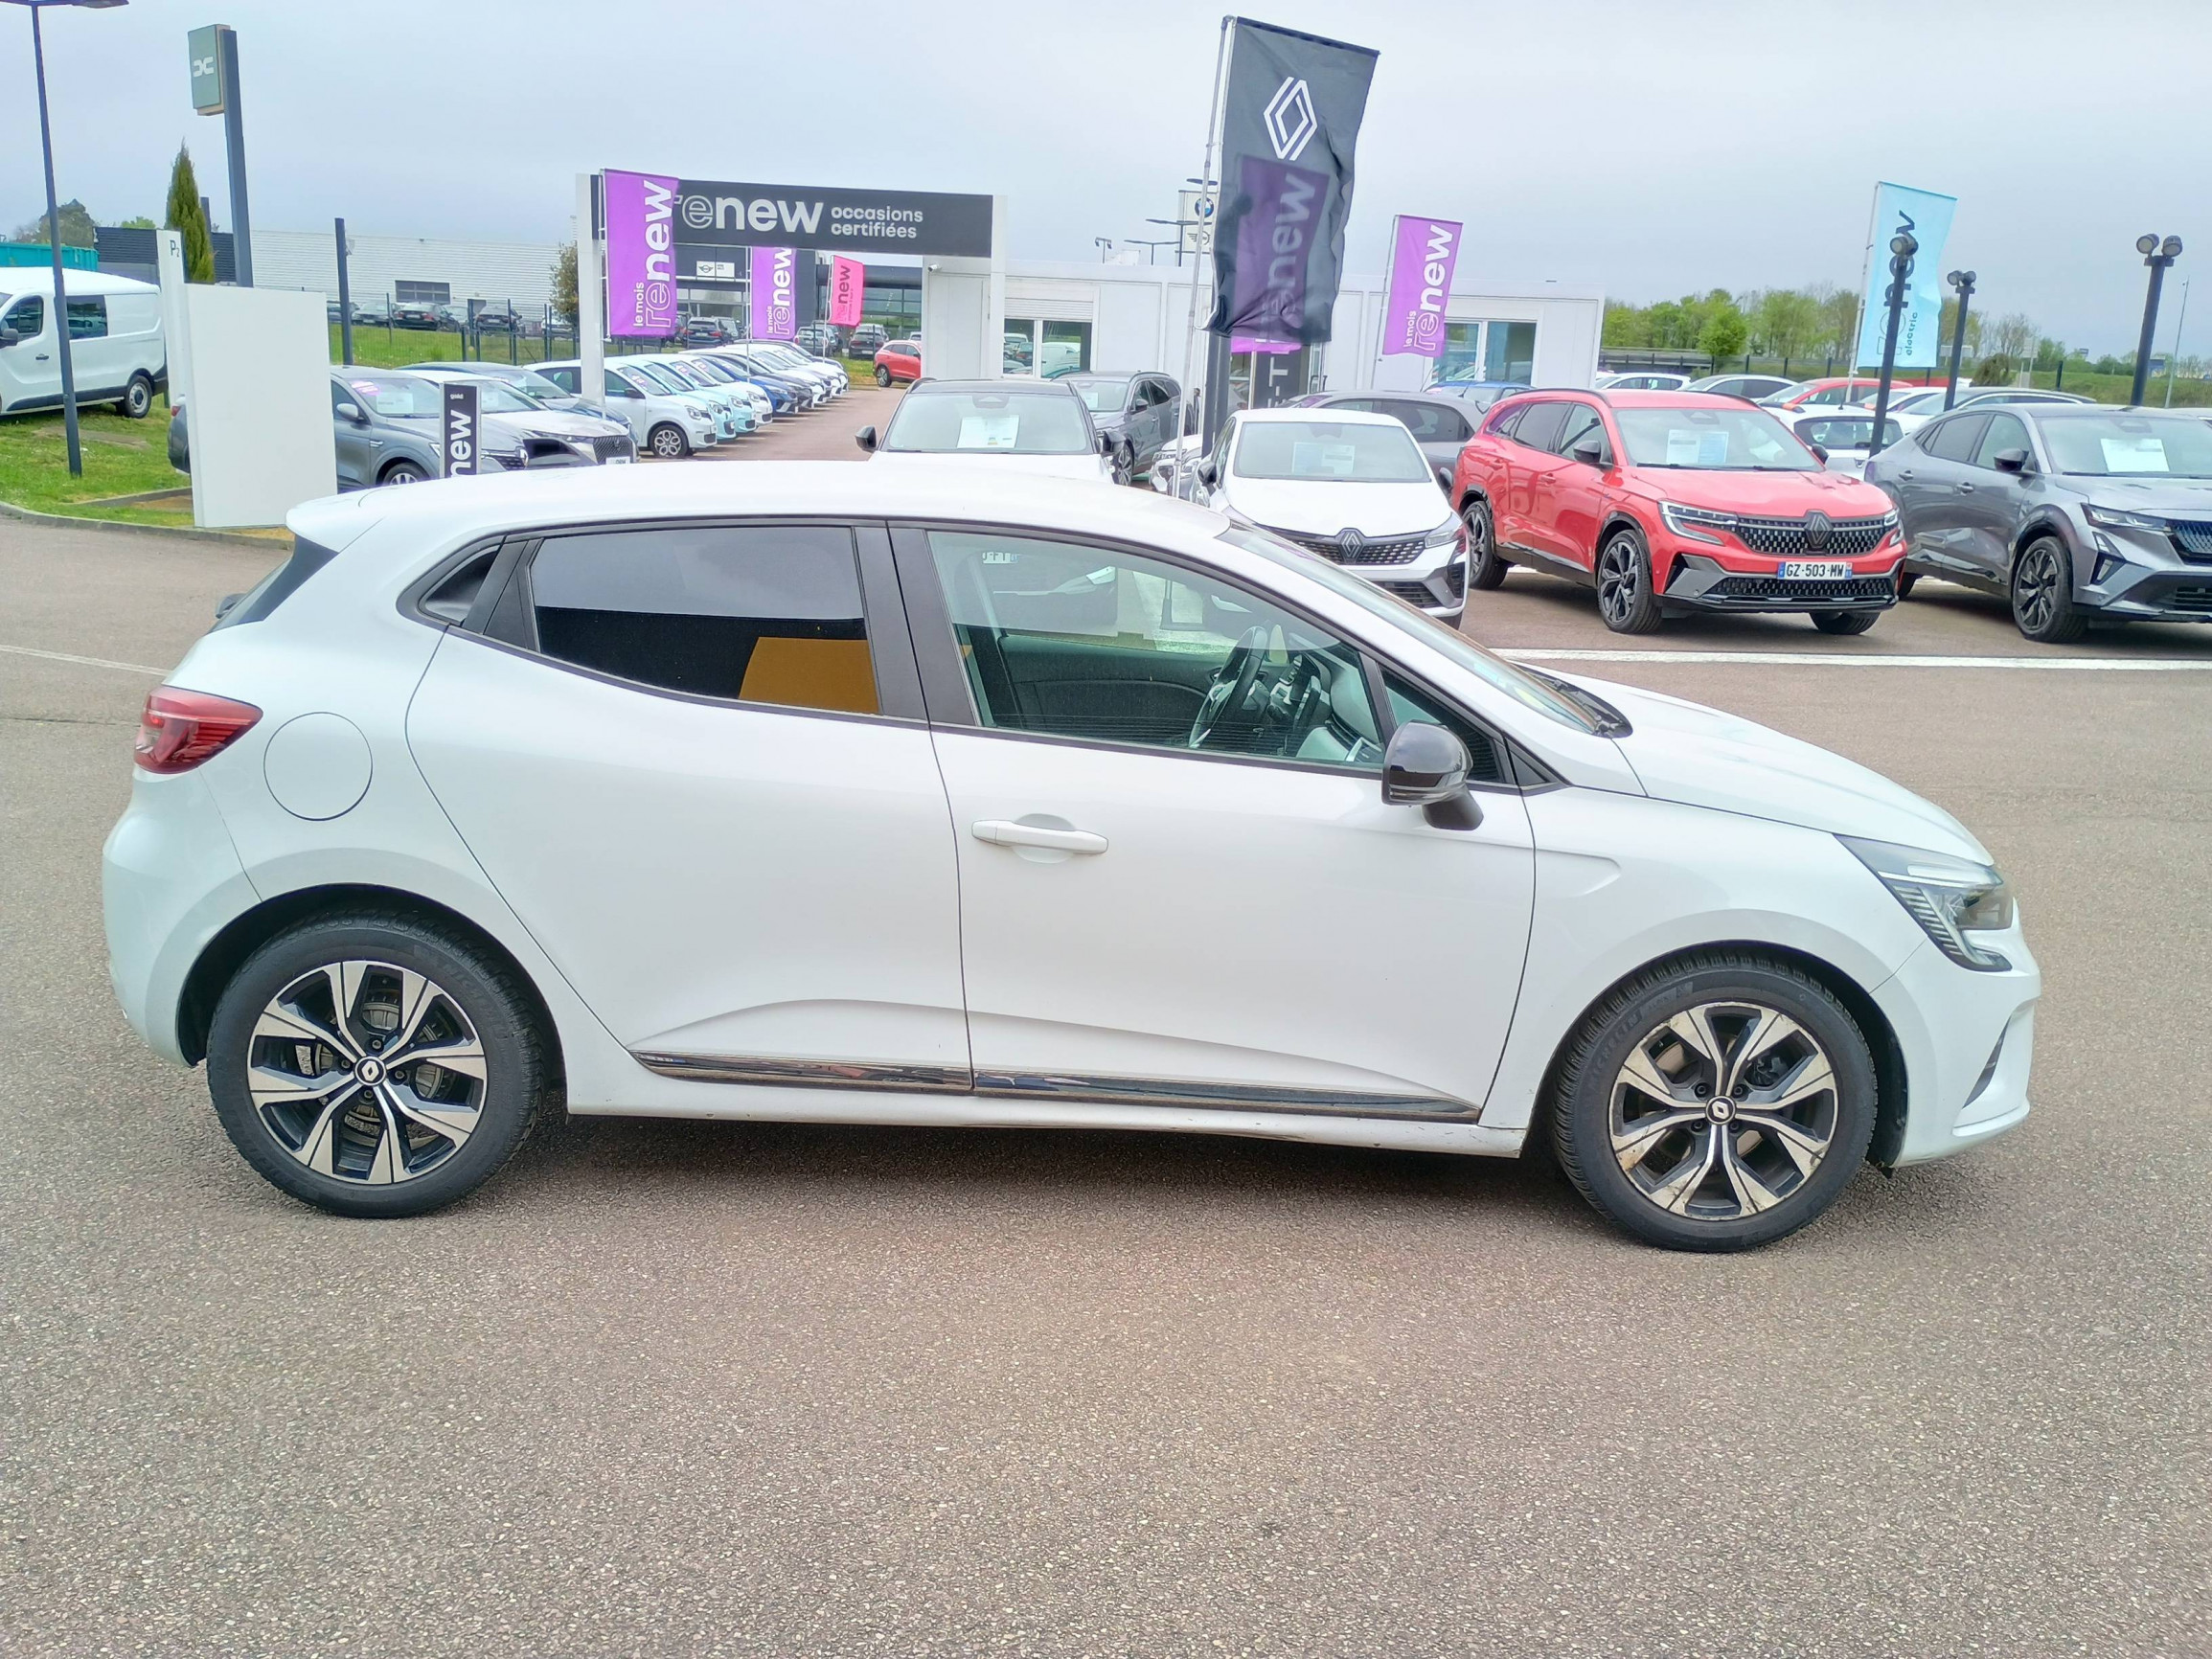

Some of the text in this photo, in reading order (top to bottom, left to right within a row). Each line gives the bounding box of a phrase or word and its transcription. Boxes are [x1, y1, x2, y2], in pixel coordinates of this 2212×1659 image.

[673, 194, 824, 234] enew
[831, 206, 924, 223] occasions
[831, 221, 917, 239] certifiées
[643, 179, 673, 329] renew
[633, 282, 645, 328] le mois
[1413, 223, 1453, 352] renew
[1402, 310, 1417, 348] le mois
